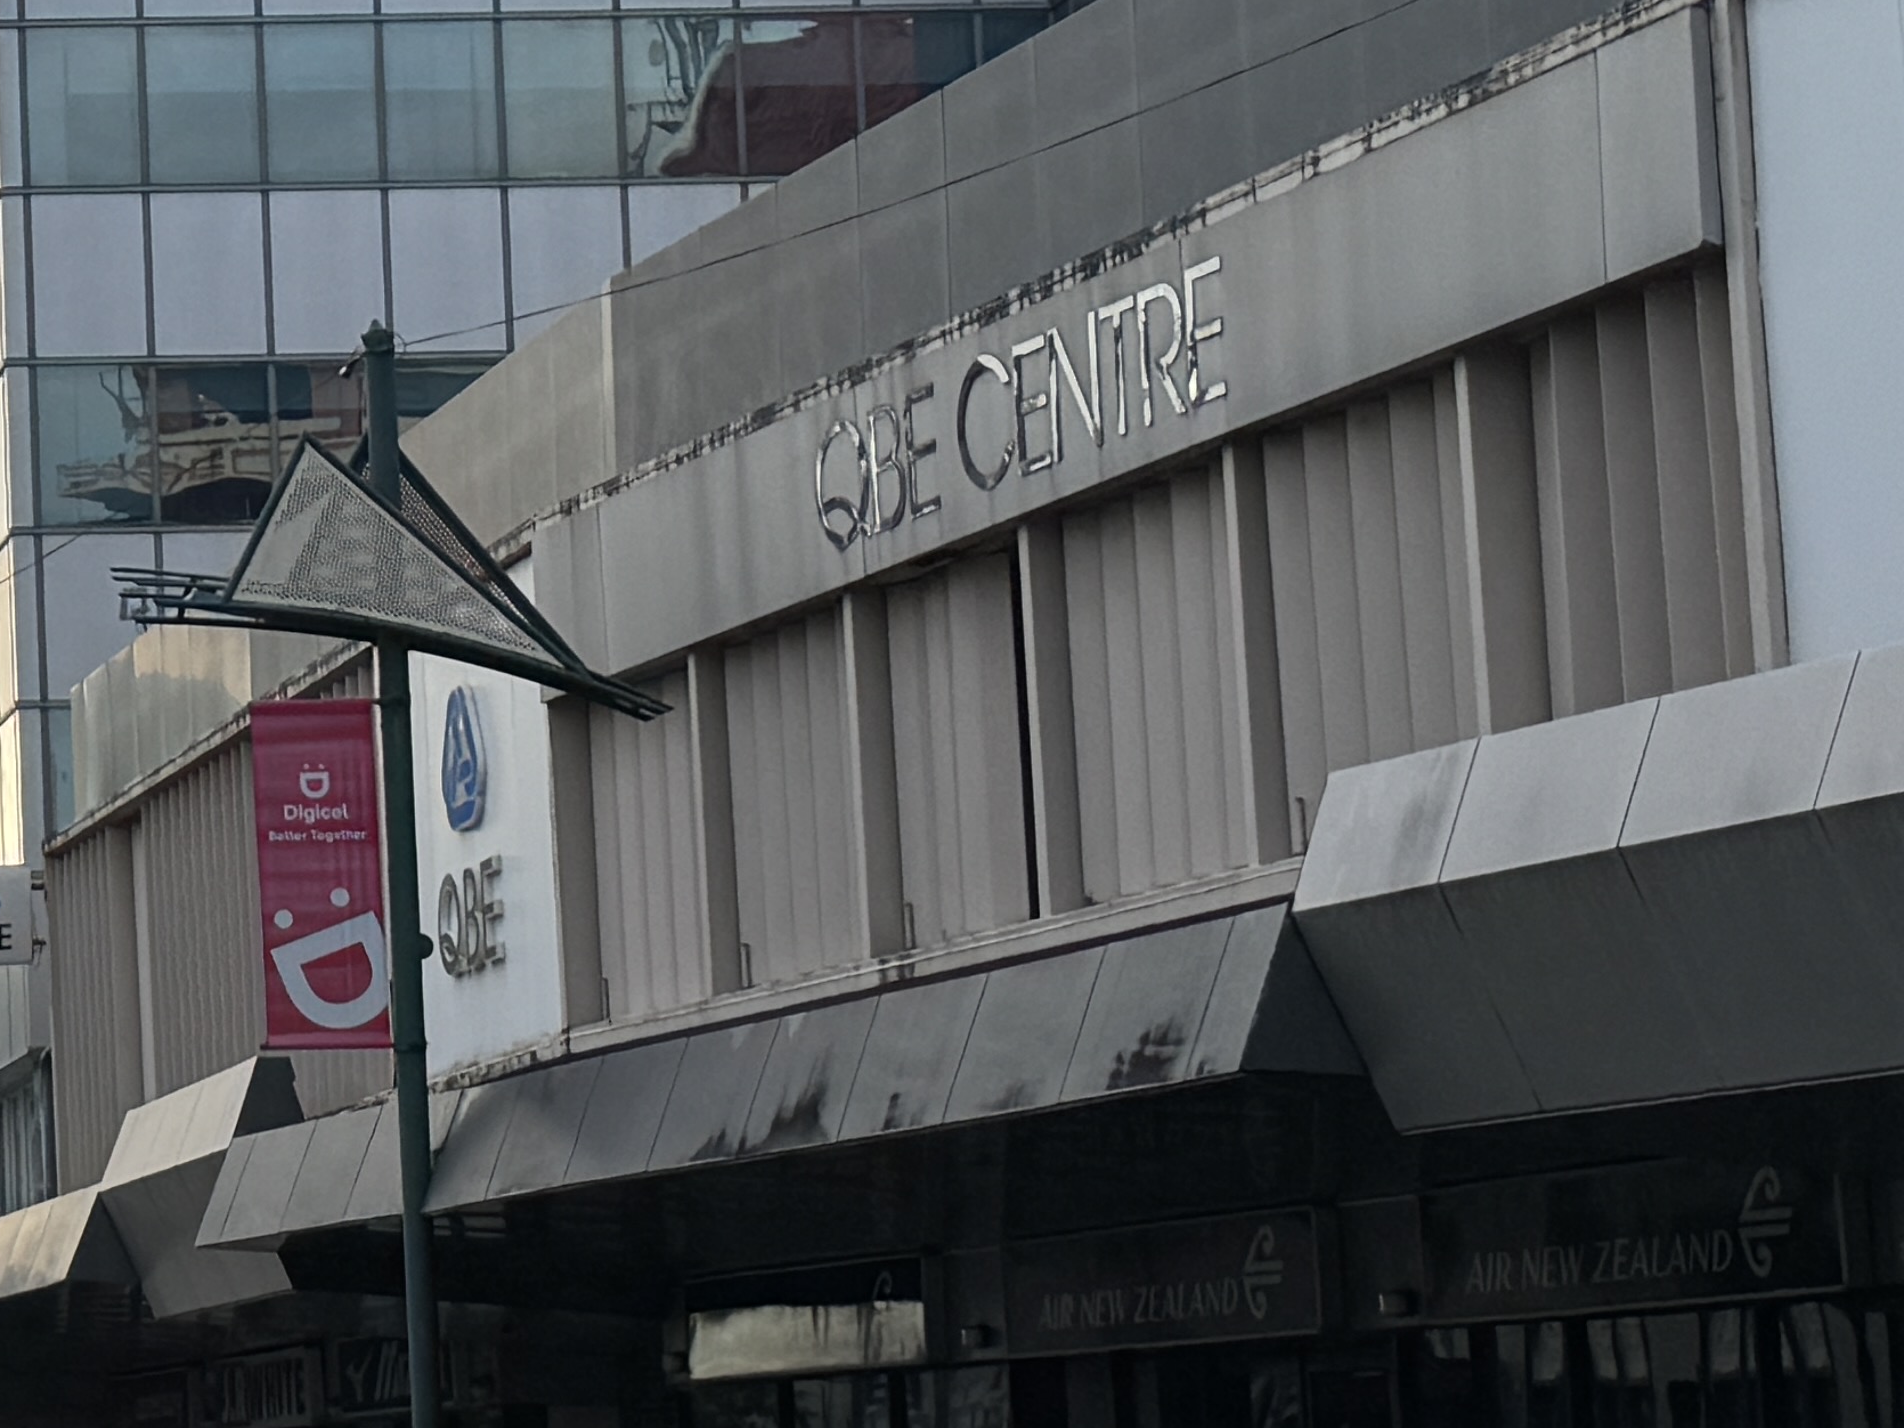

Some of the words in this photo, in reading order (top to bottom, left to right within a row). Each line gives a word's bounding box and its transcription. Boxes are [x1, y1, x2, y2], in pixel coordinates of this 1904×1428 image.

[813, 381, 942, 551] QBE
[957, 255, 1227, 490] CENTRE
[283, 804, 348, 824] Digicel
[438, 855, 506, 978] QBE
[1465, 1251, 1512, 1294] AIR
[1521, 1244, 1584, 1290] NEW
[1592, 1229, 1733, 1283] ZEALAND
[1039, 1293, 1074, 1331] AIR
[1080, 1289, 1125, 1329] NEW
[1133, 1277, 1238, 1323] ZEALAND
